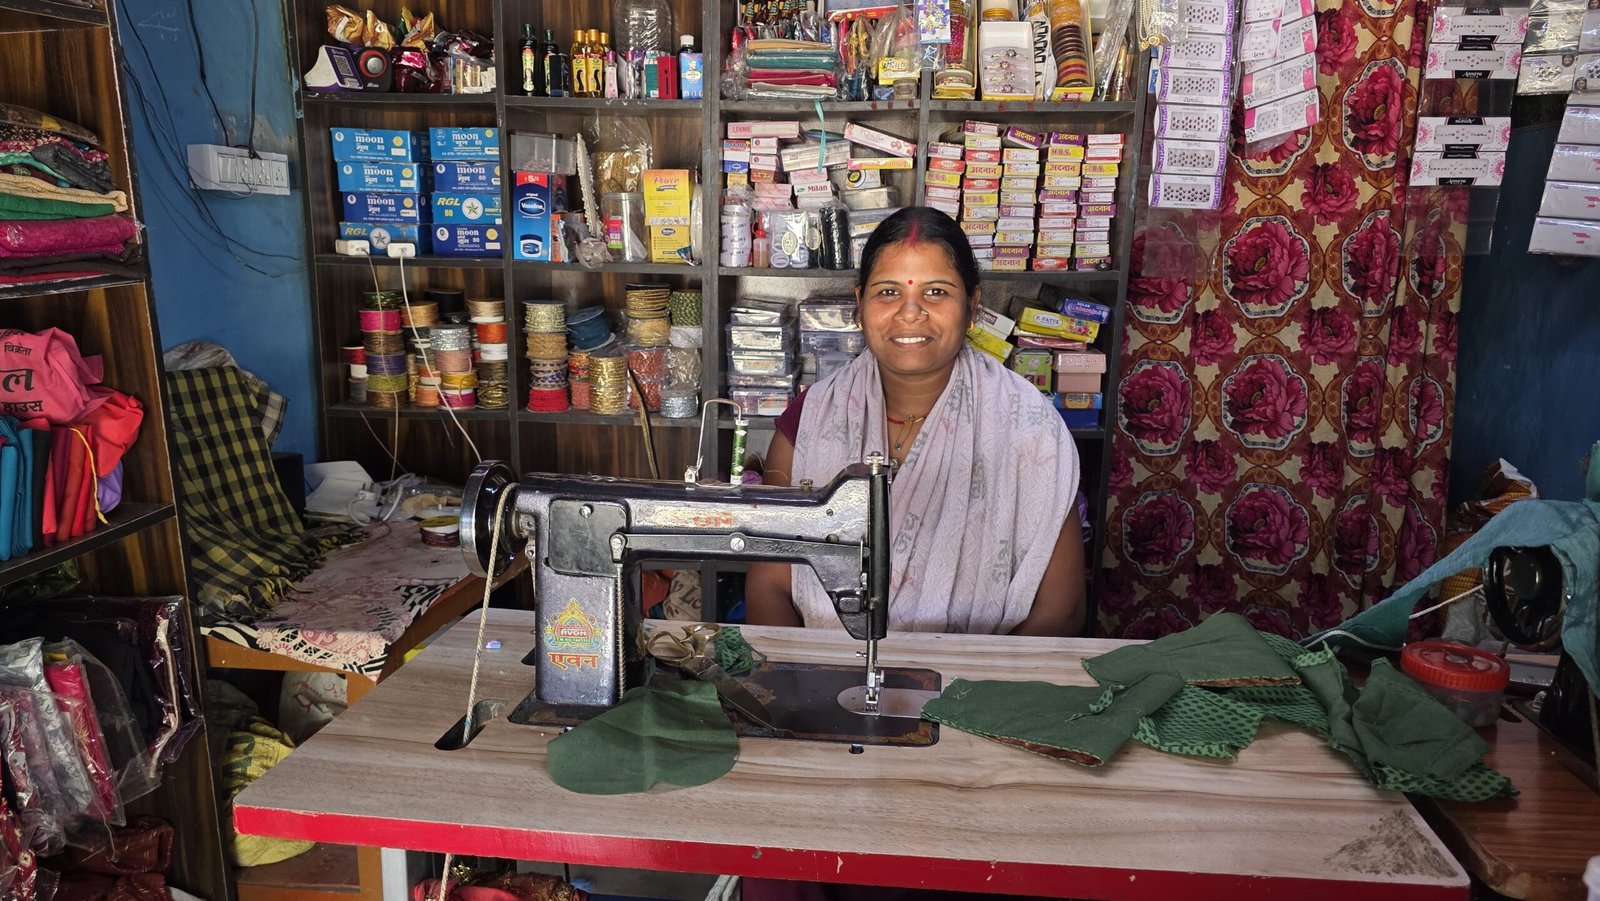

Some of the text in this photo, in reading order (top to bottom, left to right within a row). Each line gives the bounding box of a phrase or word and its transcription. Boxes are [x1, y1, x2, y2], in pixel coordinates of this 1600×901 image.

[355, 136, 384, 144] moon
[1014, 129, 1036, 143] अदनान
[1058, 133, 1080, 141] अदनान
[364, 168, 393, 176] moon
[807, 185, 828, 194] Milan
[367, 197, 395, 206] moon
[437, 197, 461, 206] RGL
[521, 202, 544, 210] Vaseline
[345, 227, 368, 236] RGL
[995, 259, 1021, 267] अदनान
[5, 342, 32, 356] विक्रेता
[1, 400, 43, 413] हाउस
[547, 652, 600, 670] एवन
